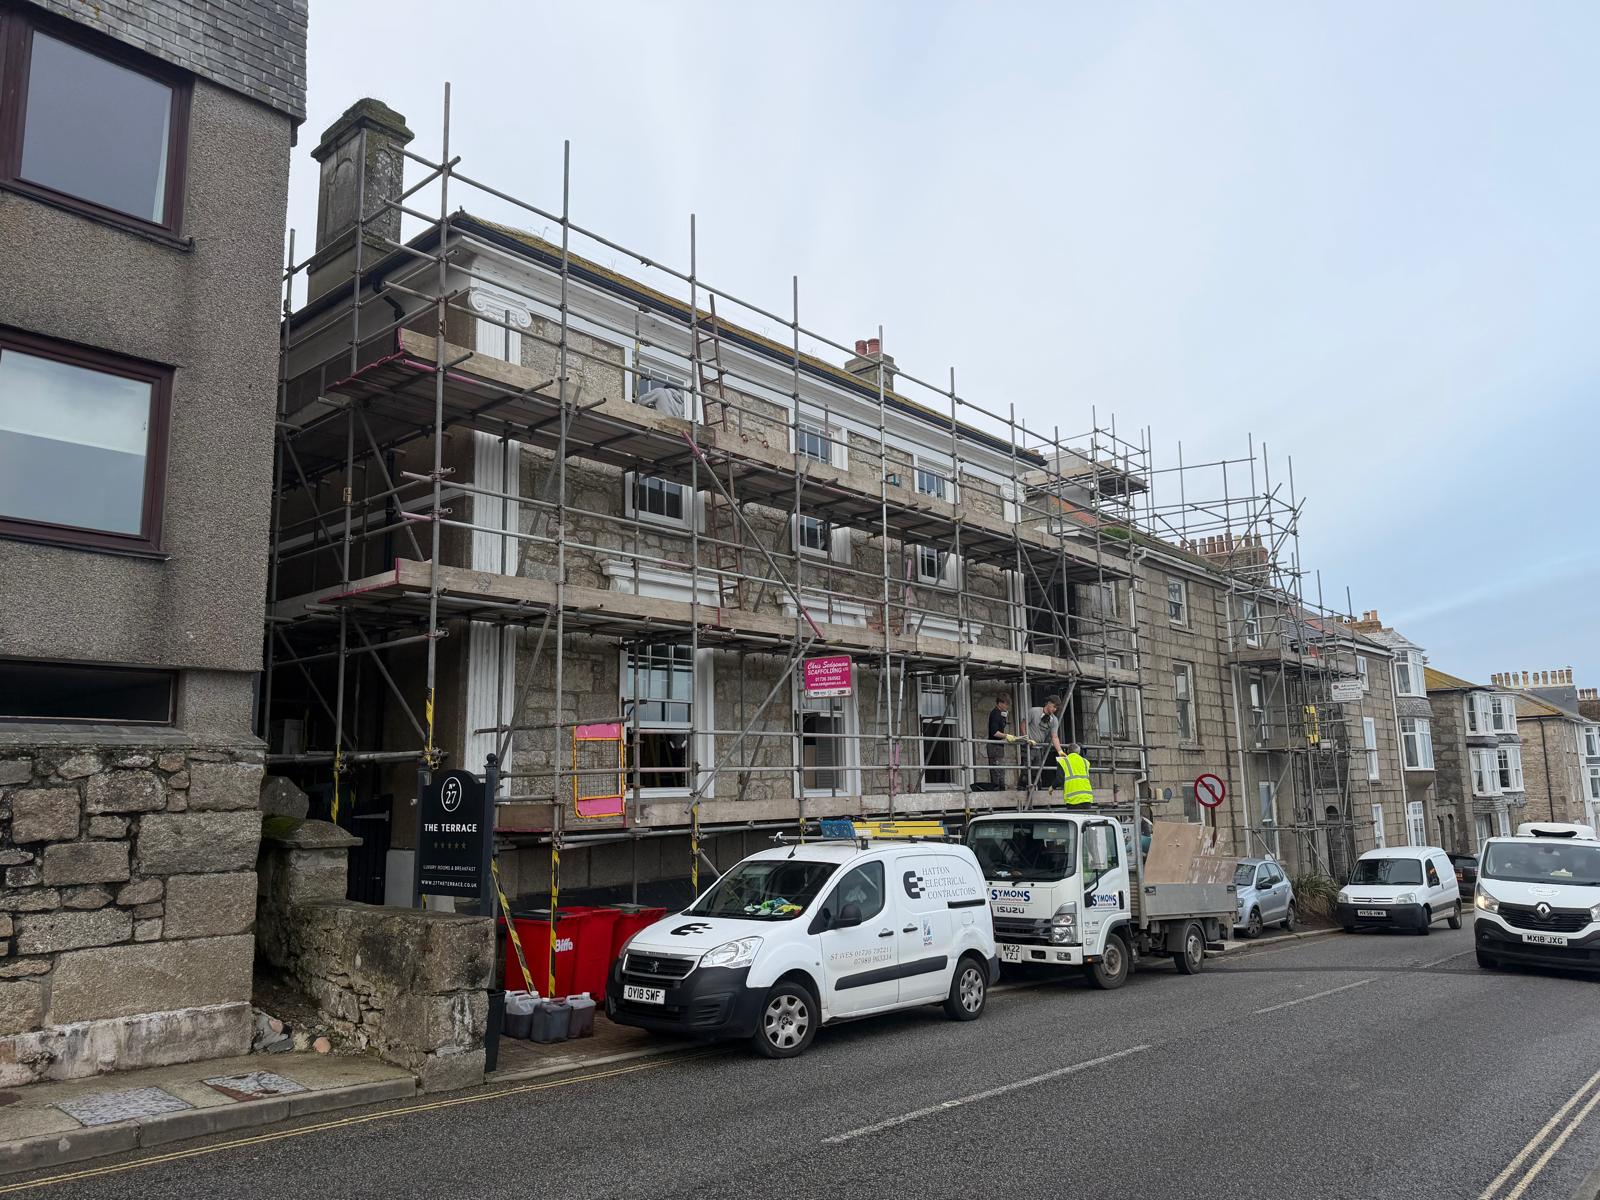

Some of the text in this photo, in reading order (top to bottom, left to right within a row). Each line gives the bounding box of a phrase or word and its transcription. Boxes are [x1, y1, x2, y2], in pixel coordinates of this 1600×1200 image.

[808, 667, 842, 676] SCAFFOLDING
[446, 790, 458, 804] 27
[424, 824, 477, 833] THE TERRACE
[922, 866, 950, 876] HATTON
[926, 876, 966, 888] ELECTRICAL
[928, 886, 976, 900] CONTRACTORS
[992, 889, 1030, 902] SYMONS
[1092, 894, 1117, 906] SYMONS
[1527, 935, 1544, 943] MX18
[1005, 952, 1018, 960] YZJ
[628, 987, 661, 1001] OY18 SWF
